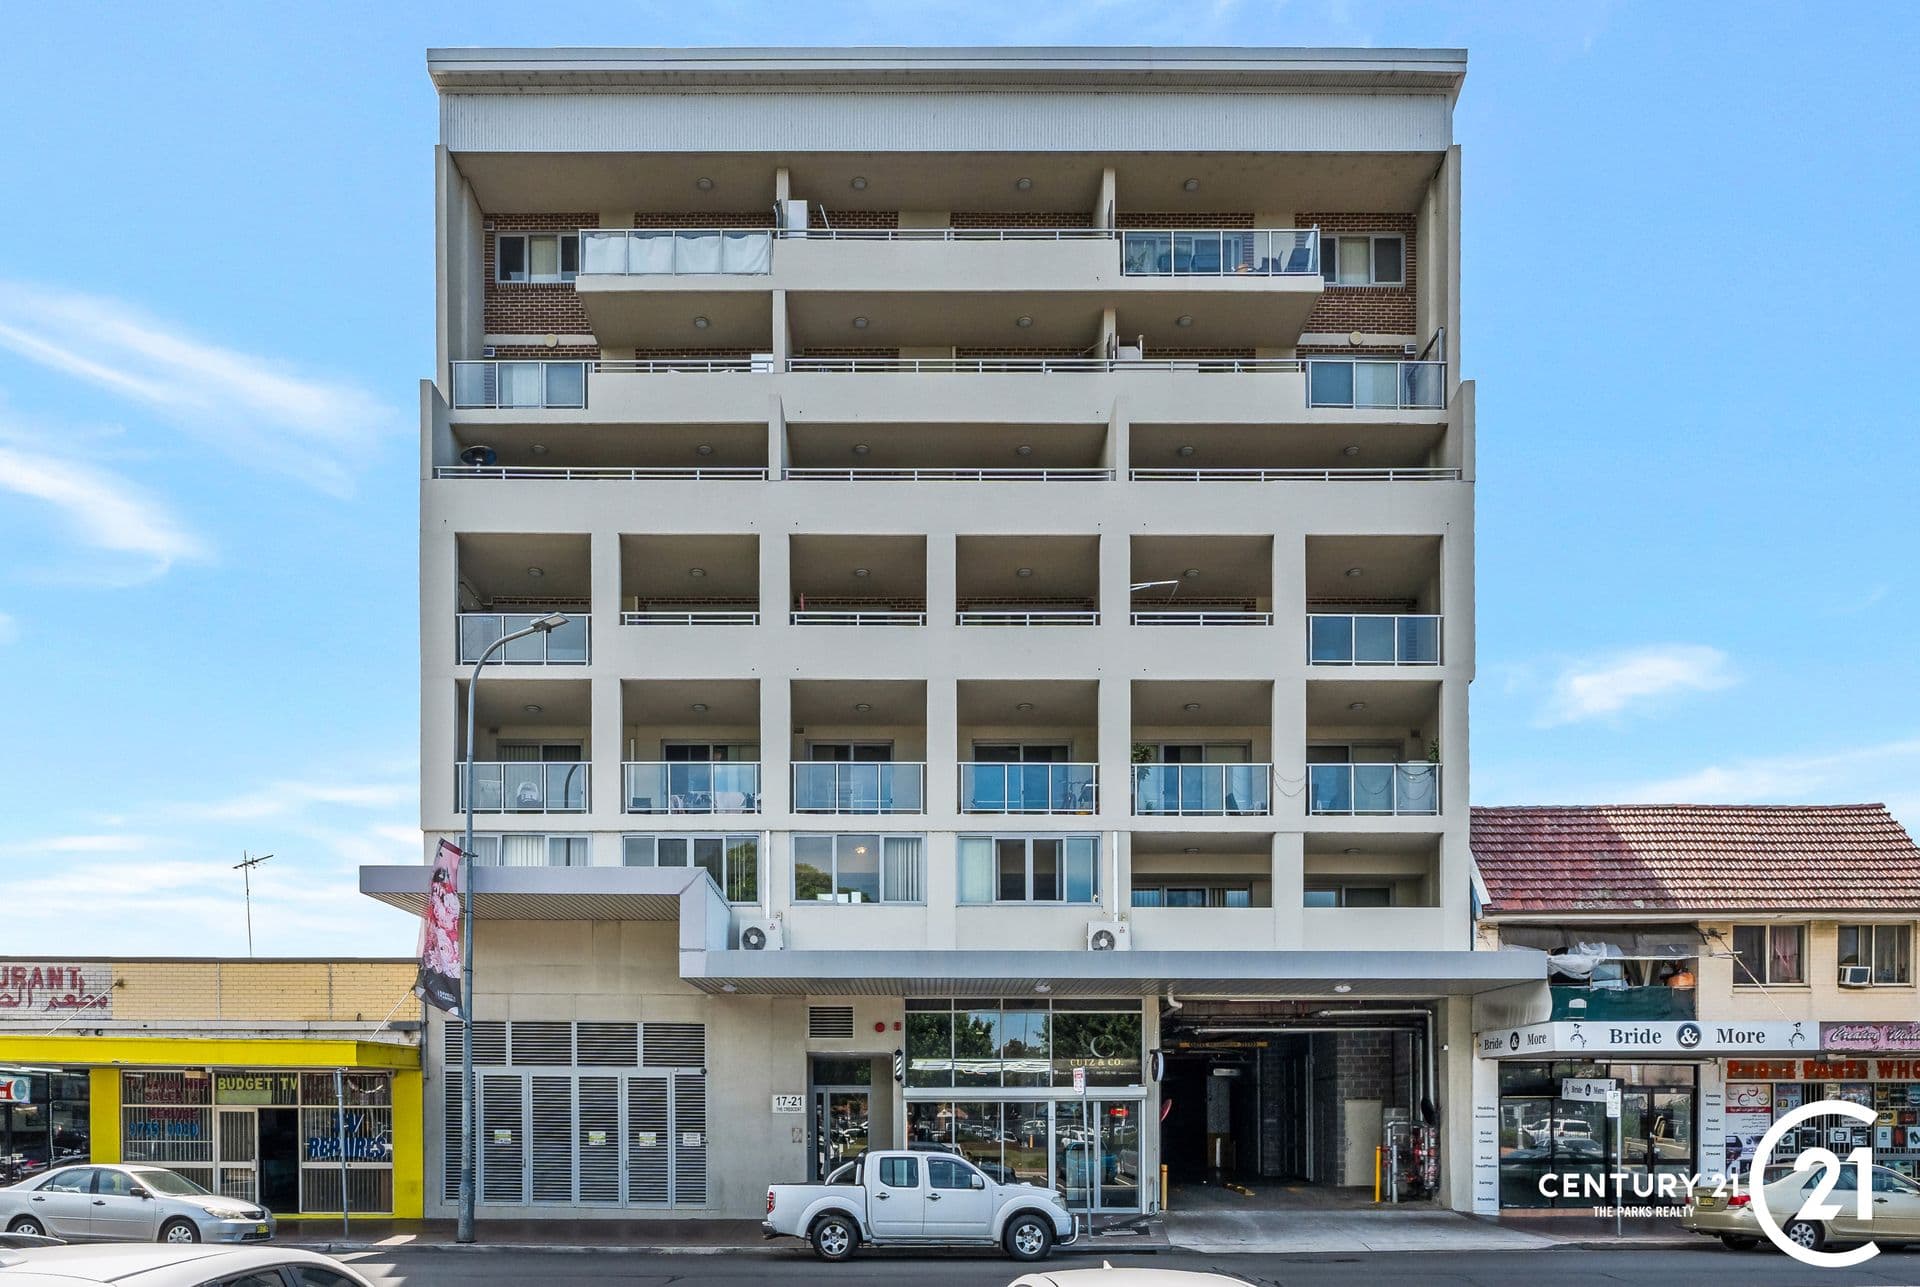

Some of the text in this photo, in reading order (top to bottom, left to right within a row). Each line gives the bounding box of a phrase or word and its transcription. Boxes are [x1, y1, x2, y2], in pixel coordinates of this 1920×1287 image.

[1484, 1038, 1503, 1050] Bride
[1527, 1033, 1547, 1045] More
[1609, 1027, 1766, 1044] Bride & More
[217, 1077, 273, 1090] BUDGET
[280, 1077, 298, 1090] TV
[775, 1096, 802, 1107] 17-21
